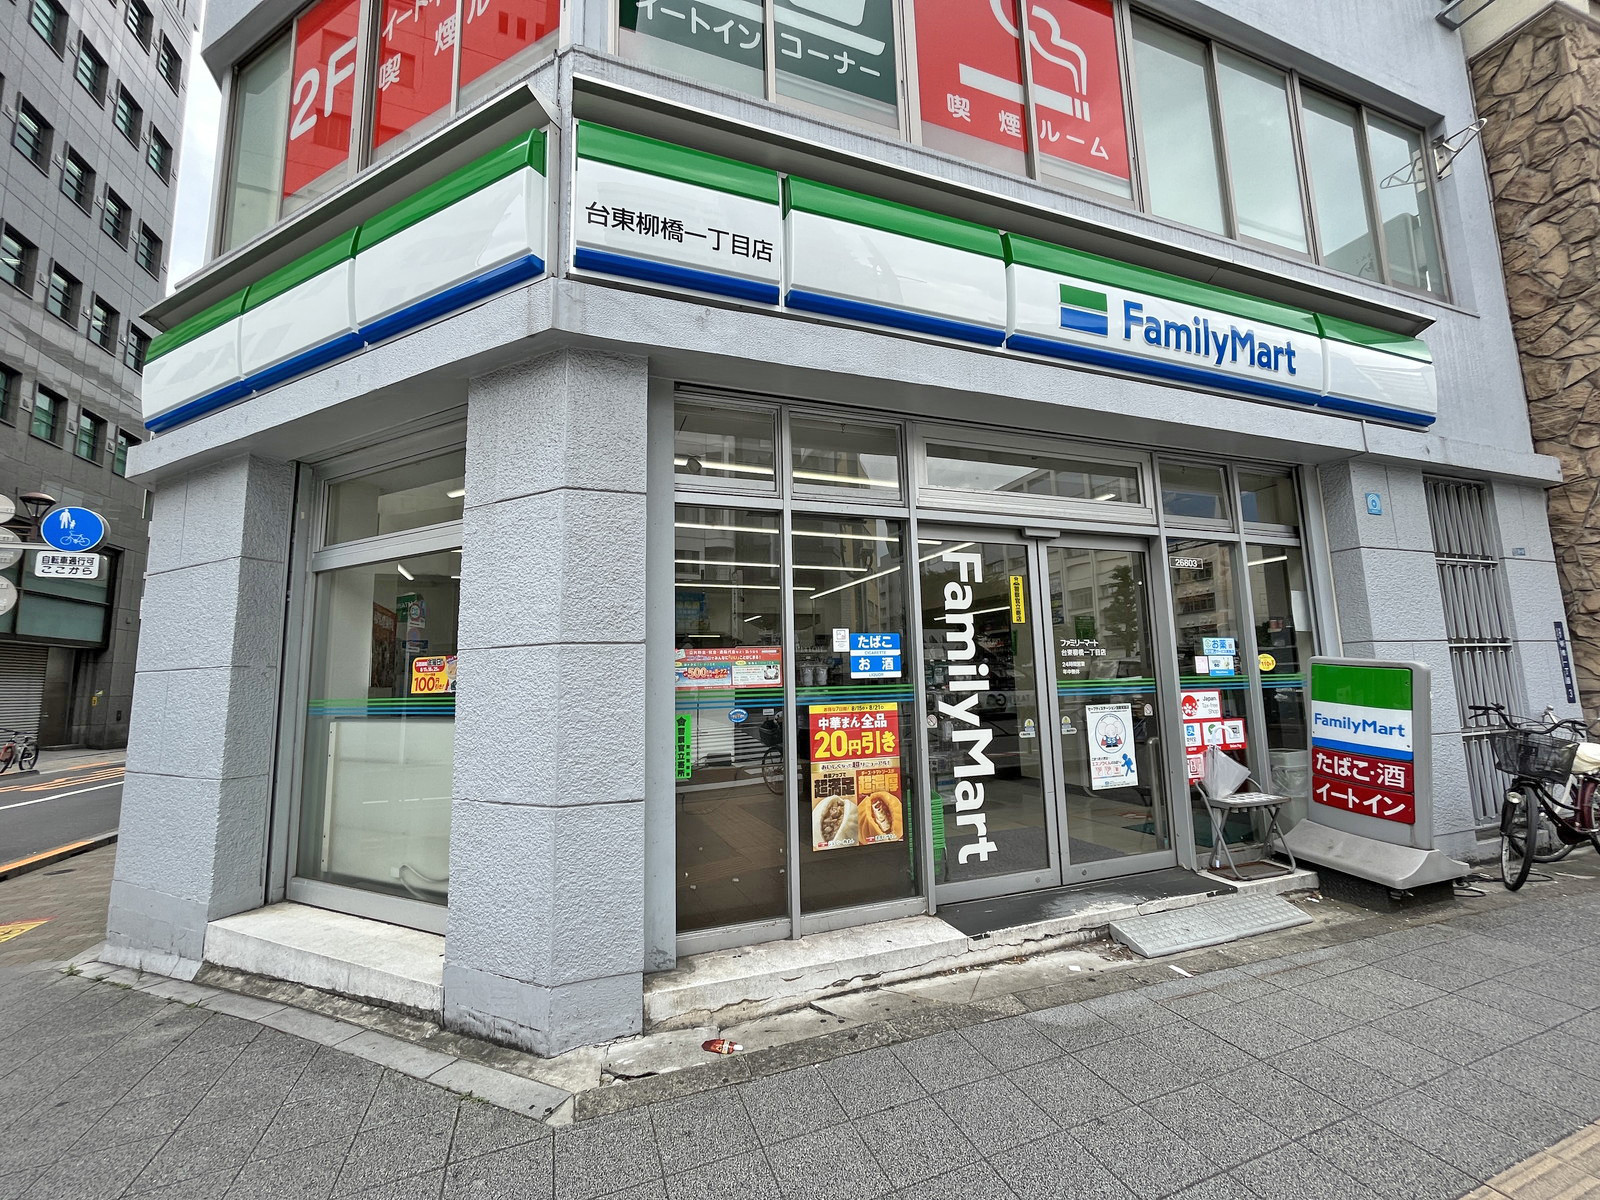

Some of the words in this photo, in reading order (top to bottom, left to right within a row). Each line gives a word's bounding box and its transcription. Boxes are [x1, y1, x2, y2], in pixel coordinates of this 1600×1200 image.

[290, 36, 357, 140] 2F
[585, 201, 774, 263] 台東柳橋一丁目店
[1122, 299, 1297, 376] FamilyMart
[41, 566, 93, 575] ここから
[42, 555, 95, 565] 自転車通行可
[1175, 559, 1198, 568] 26803
[857, 635, 893, 649] たばこ
[1060, 639, 1099, 647] ファミリーマート
[938, 552, 998, 865] FamilyMart
[818, 713, 888, 731] 中華まん全品
[1314, 712, 1405, 737] FamilyMart
[814, 730, 896, 759] 20円引き
[1316, 752, 1406, 789] たばこ・酒
[814, 776, 855, 799] 超満足
[1316, 783, 1406, 816] イートイン
